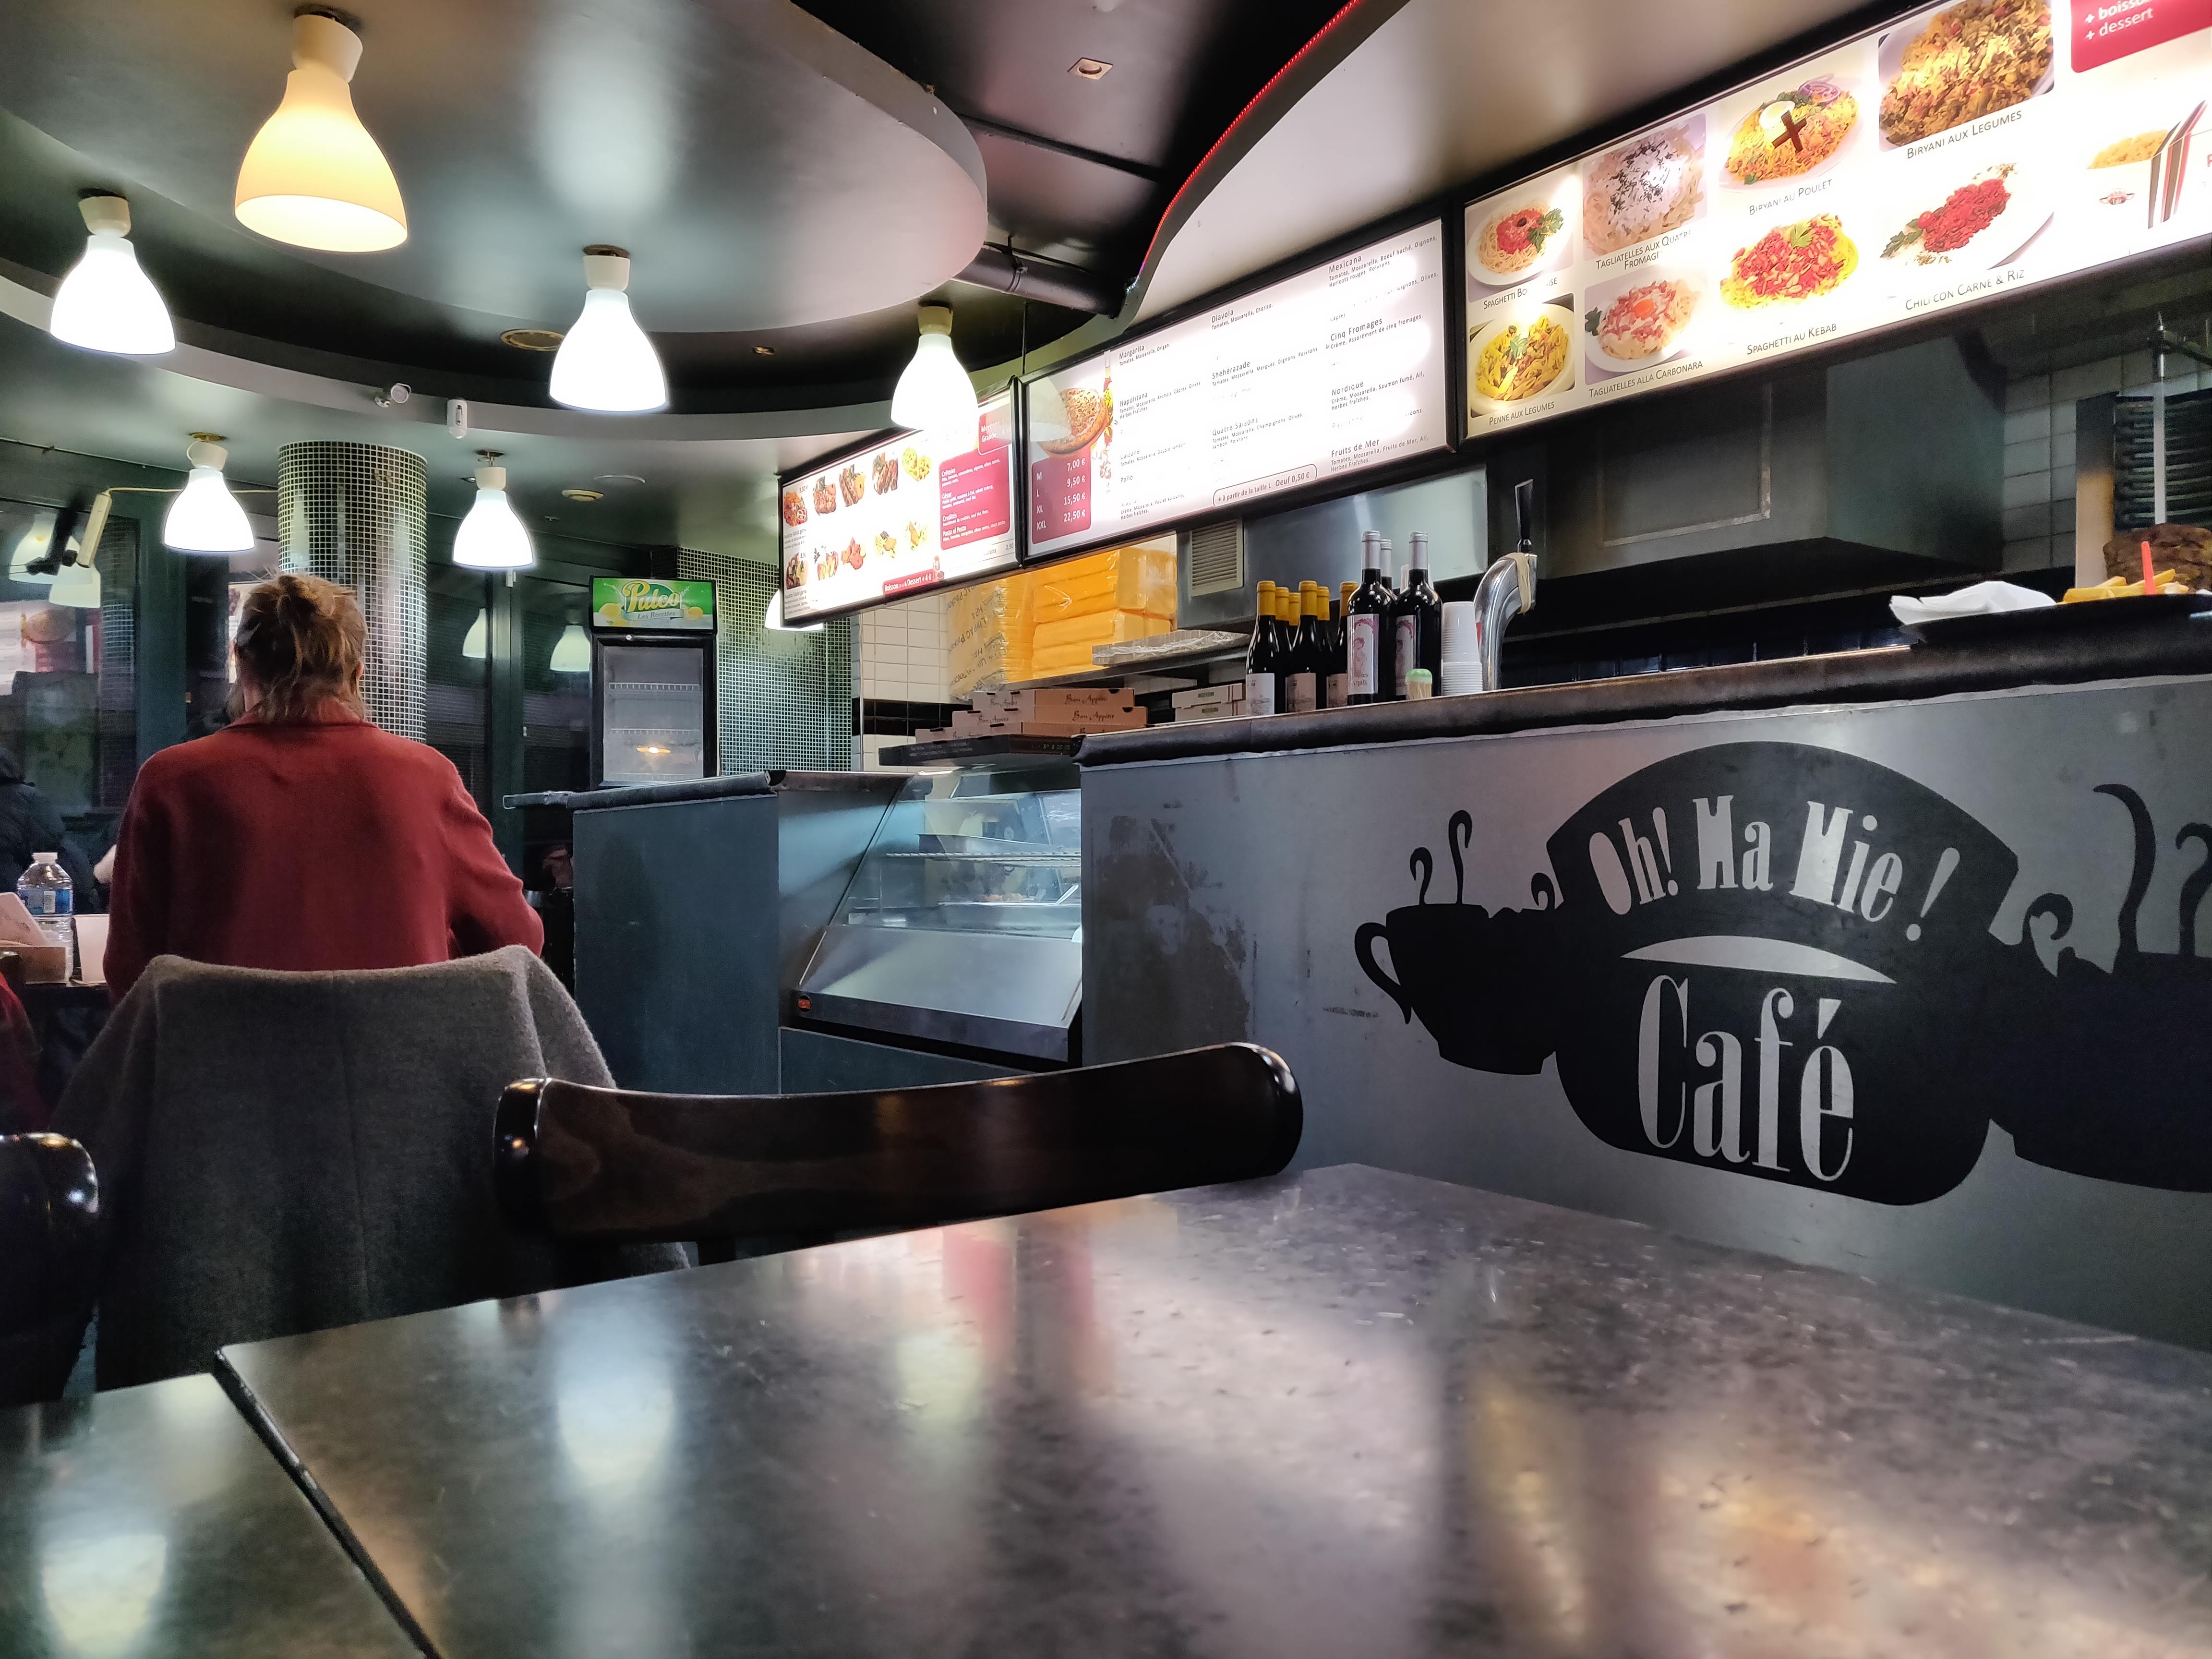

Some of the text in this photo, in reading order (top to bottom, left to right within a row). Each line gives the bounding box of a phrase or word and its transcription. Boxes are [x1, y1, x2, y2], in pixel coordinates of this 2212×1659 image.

[2099, 7, 2153, 36] dessert
[1908, 110, 2022, 159] BIRYANI AUX LEGUMES
[1749, 179, 1832, 215] BIRYANI AU POULET
[1329, 235, 1437, 282] Tomates, Mozzarella, Boeuf haché, Oignons,
[1329, 255, 1362, 274] Mexicana
[1596, 247, 1643, 269] TAGLIATELLES
[1645, 241, 1660, 253] AUX
[1329, 277, 1348, 288] Haricots
[1350, 271, 1366, 280] rouges
[1906, 270, 2024, 310] CHILI CON CARNE & RIZ
[1484, 292, 1515, 310] SPAGHETTI
[1212, 309, 1233, 323] Diavola
[1331, 318, 1382, 341] Cinq Fromages
[1349, 329, 1377, 343] Assortiment
[1386, 322, 1396, 331] cinq
[1747, 324, 1837, 355] SPAGHETTI AU KEBAB
[1119, 345, 1144, 360] Margarita
[1212, 361, 1250, 380] Shéhérazade
[1589, 361, 1703, 398] TAGLIATELLES ALLA CARBONARA
[1332, 381, 1364, 396] Nordique
[1379, 380, 1398, 390] Saumon
[1120, 392, 1148, 407] Napolitana
[1490, 401, 1554, 425] PENNE AUX LEGUMES
[981, 421, 1000, 433] Moyenne
[982, 433, 997, 443] Grande
[1332, 438, 1380, 457] Fruits de Mer
[1354, 448, 1381, 460] Mozzarella,
[1383, 443, 1397, 451] Fruits
[1036, 471, 1042, 481] M
[1067, 459, 1080, 472] 7,00
[1331, 464, 1347, 472] Herbes
[1036, 489, 1040, 497] L
[1067, 476, 1080, 488] 9,50
[1227, 491, 1240, 502] partir
[1254, 485, 1267, 493] taille
[1275, 476, 1290, 487] Oeuf
[1291, 472, 1305, 483] 0,50
[1036, 505, 1043, 514] XL
[1064, 493, 1080, 505] 15,50
[1036, 520, 1046, 530] XXL
[1064, 510, 1080, 522] 22,50
[884, 583, 899, 591] Boisson
[907, 577, 922, 586] Dessert
[622, 580, 680, 613] Pulco
[1065, 694, 1080, 704] Bon
[1072, 710, 1088, 721] Bon
[1589, 807, 1678, 915] Oh!
[1693, 794, 1773, 891] Ma
[1789, 800, 1902, 922] Mie
[1638, 974, 1854, 1181] Café
